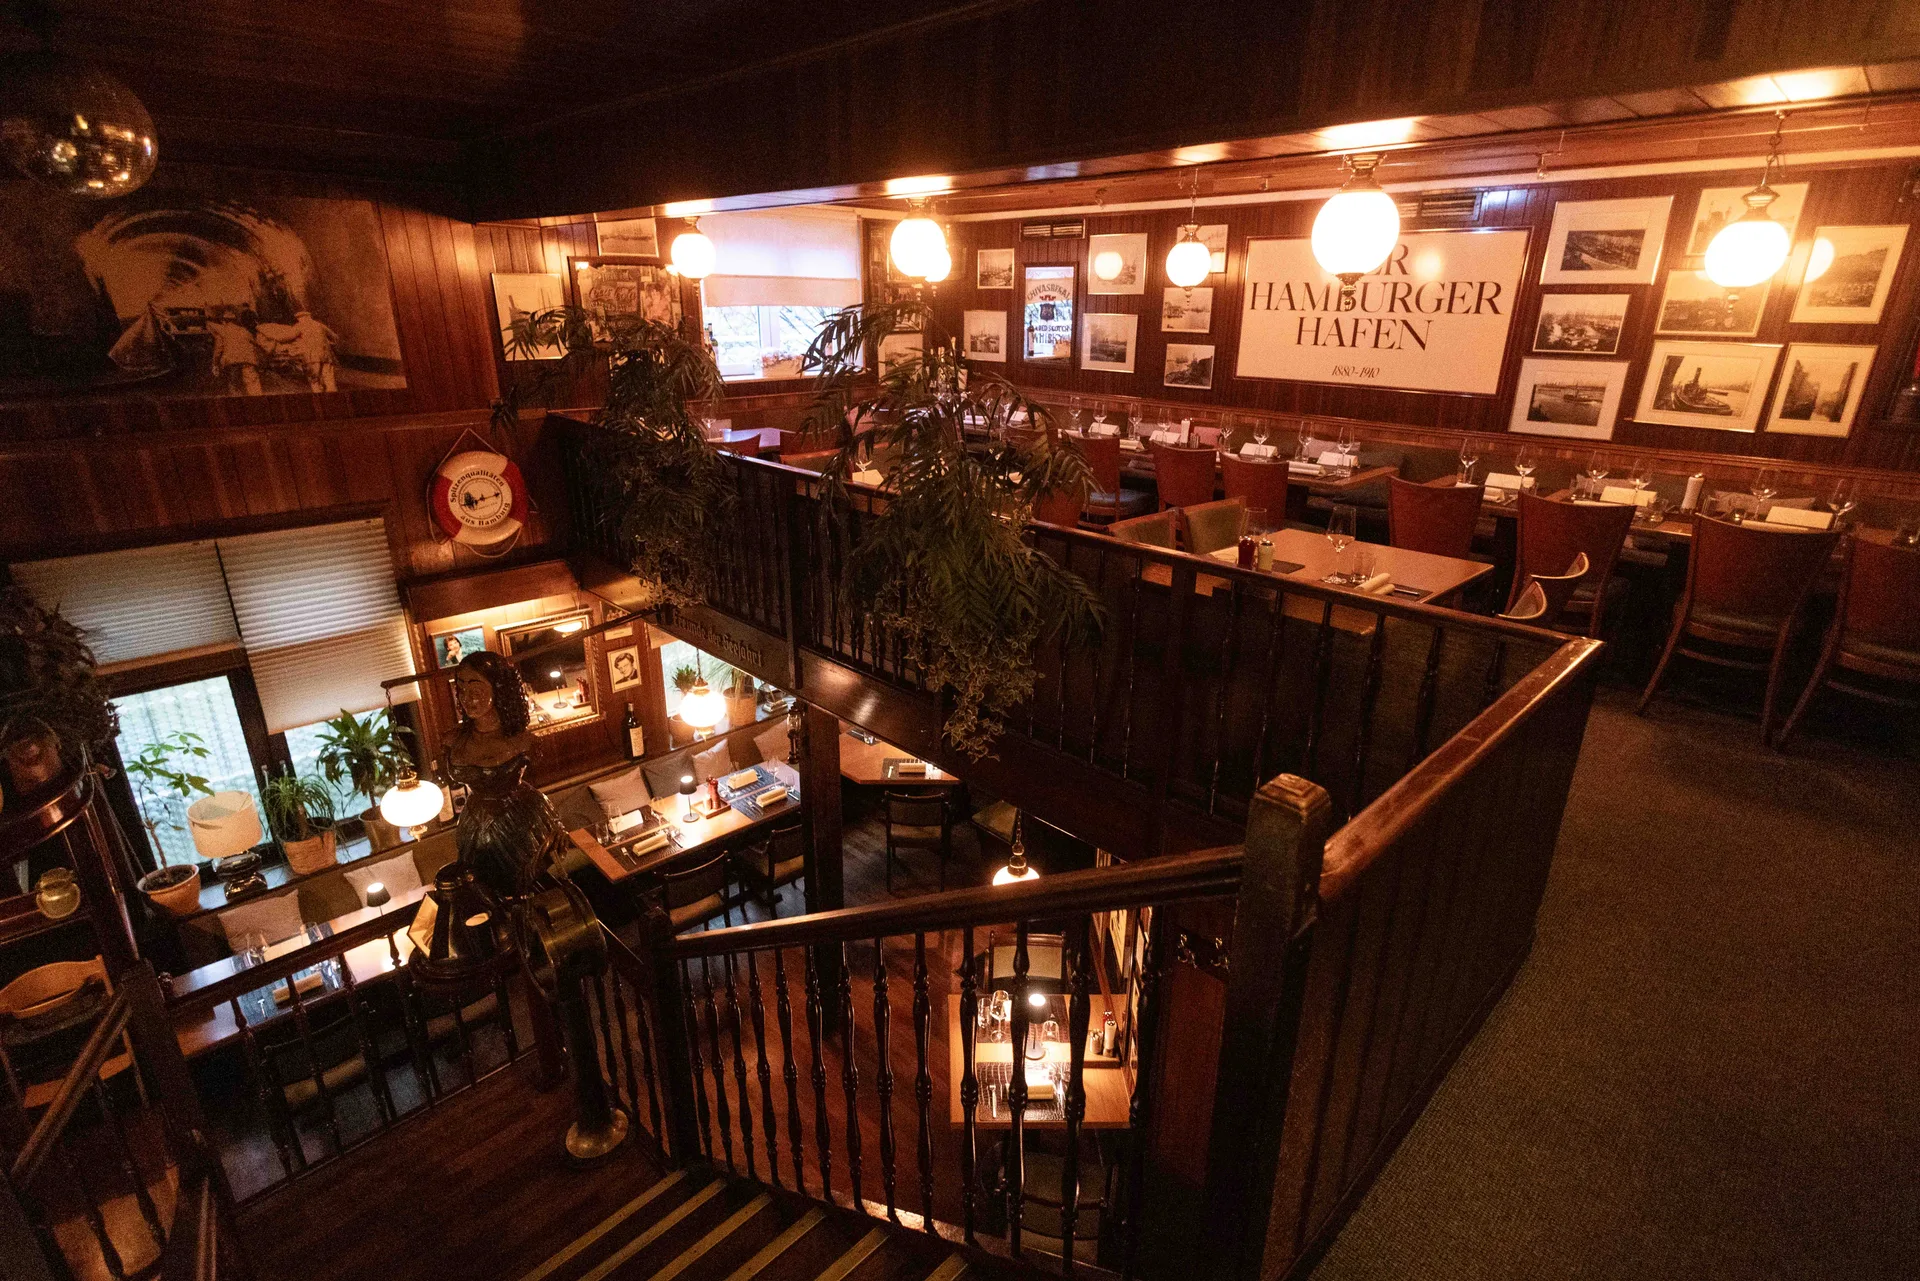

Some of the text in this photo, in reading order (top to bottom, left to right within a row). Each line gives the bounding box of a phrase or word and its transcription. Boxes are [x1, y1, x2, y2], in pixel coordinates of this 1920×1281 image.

[1250, 280, 1504, 315] HAMBURGER
[1296, 316, 1434, 351] HAFEN
[460, 502, 510, 526] aus Hamburg
[707, 626, 721, 647] der
[723, 634, 762, 667] Seefahrt
